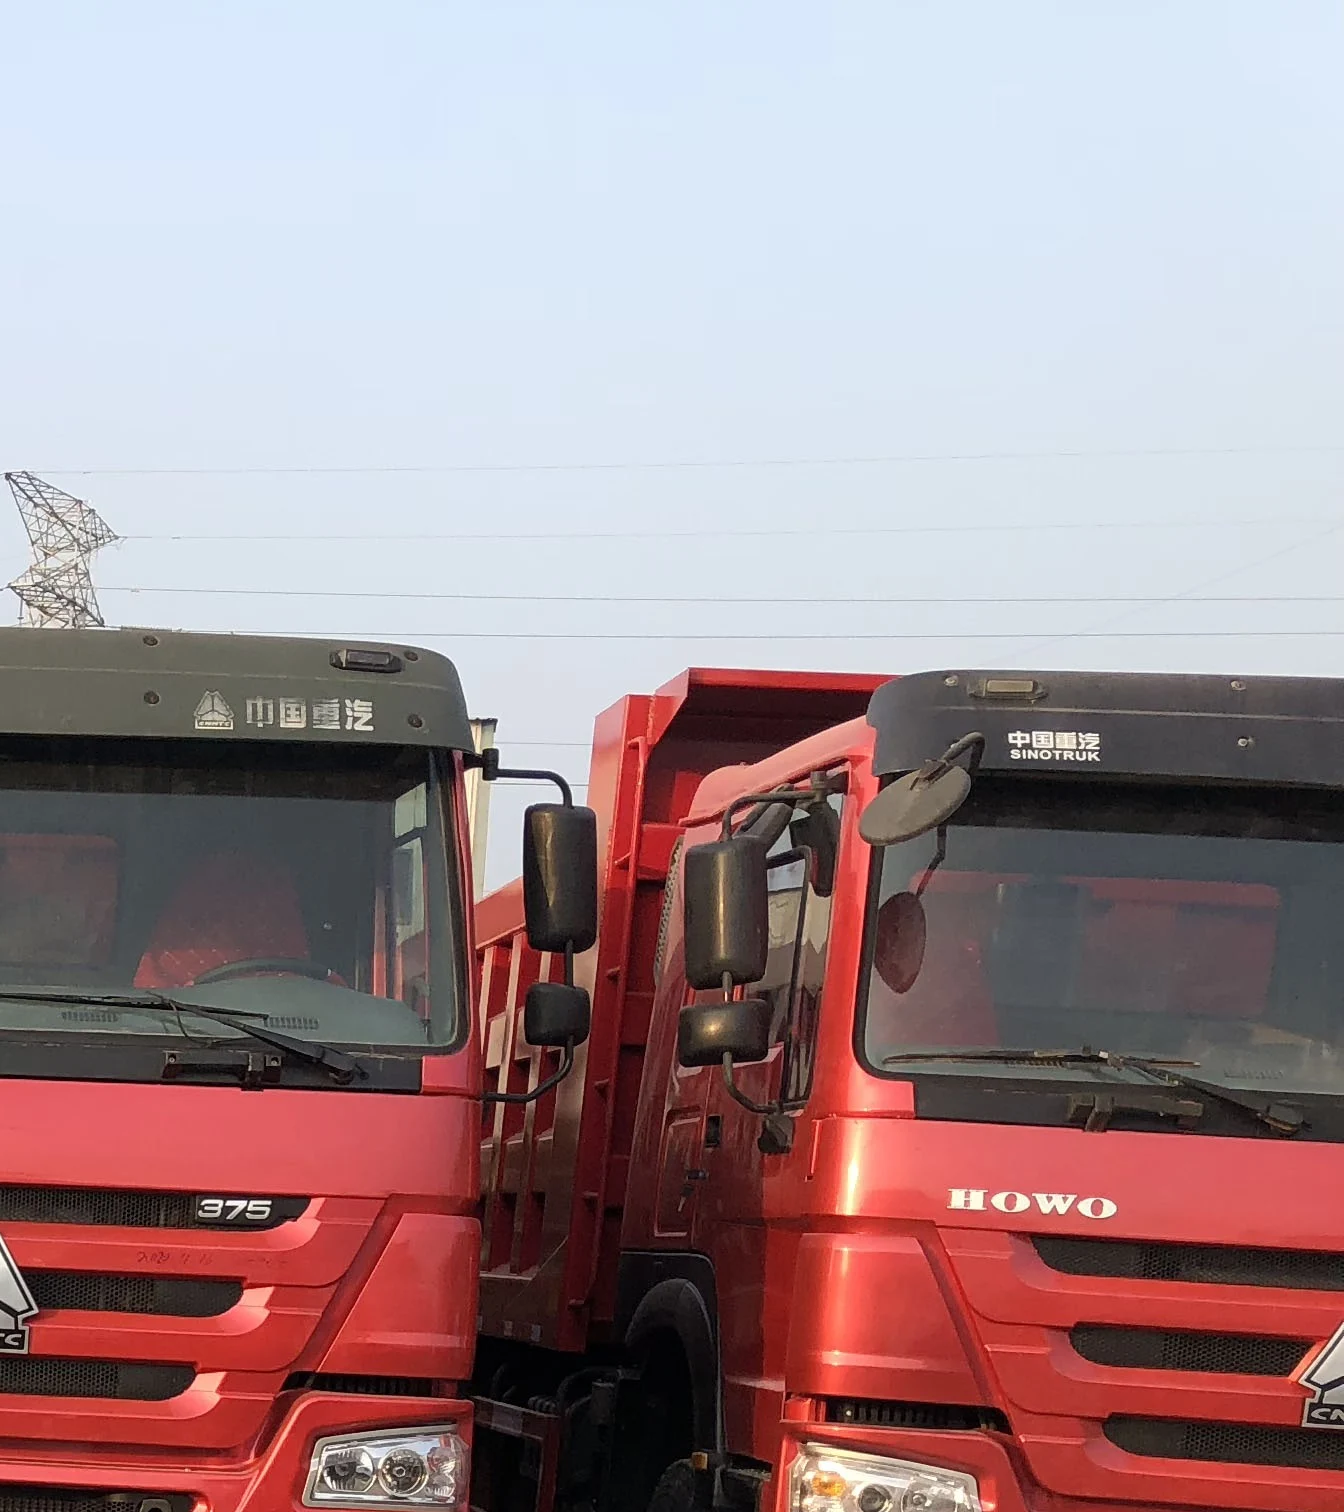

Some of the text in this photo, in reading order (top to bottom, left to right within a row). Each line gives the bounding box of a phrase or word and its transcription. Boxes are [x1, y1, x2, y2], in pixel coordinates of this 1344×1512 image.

[245, 696, 375, 732] 中国重汽
[1007, 730, 1101, 750] 中国重汽
[1010, 749, 1101, 762] SINOTRUK
[197, 1198, 272, 1220] 375
[946, 1188, 1118, 1219] HOWO
